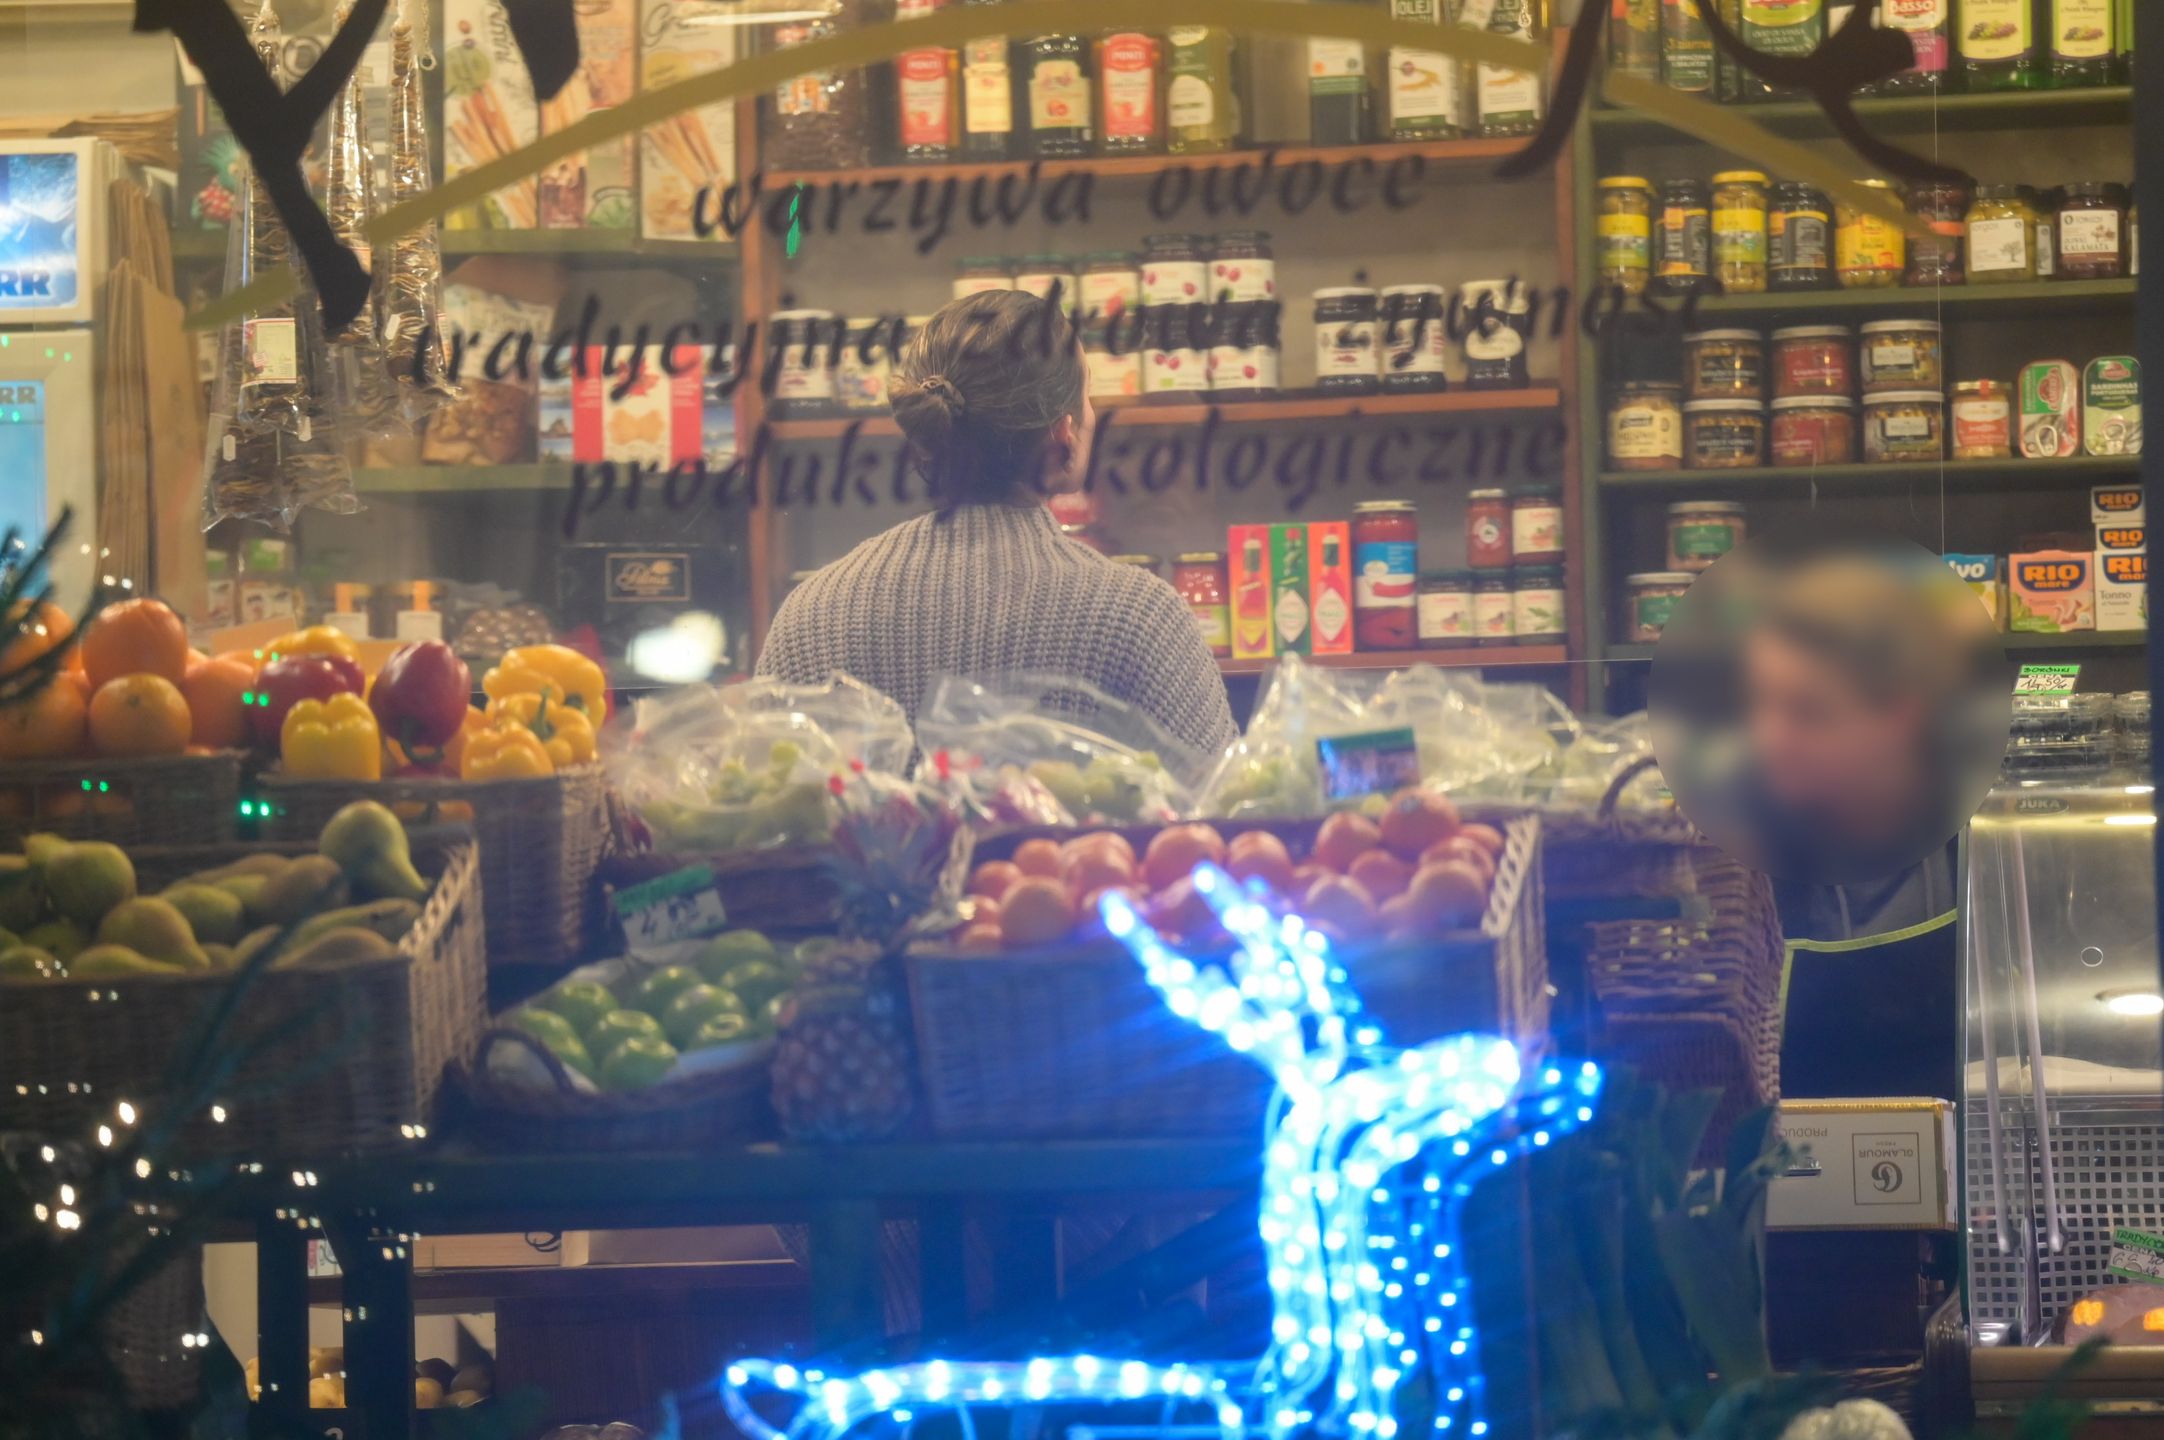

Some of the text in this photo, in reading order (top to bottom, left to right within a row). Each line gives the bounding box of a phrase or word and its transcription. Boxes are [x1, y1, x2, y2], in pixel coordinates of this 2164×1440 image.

[692, 148, 1428, 256] warzywa owoce
[409, 292, 910, 402] tradycyjna
[1031, 405, 1567, 513] ekologiczne
[2099, 492, 2139, 505] RIO
[2103, 530, 2143, 542] RIO
[2023, 563, 2080, 582] RIO
[2107, 556, 2147, 574] RI
[2099, 590, 2133, 600] Tonno
[2019, 799, 2061, 809] JUKA
[1858, 1148, 1914, 1159] GLAMOUR
